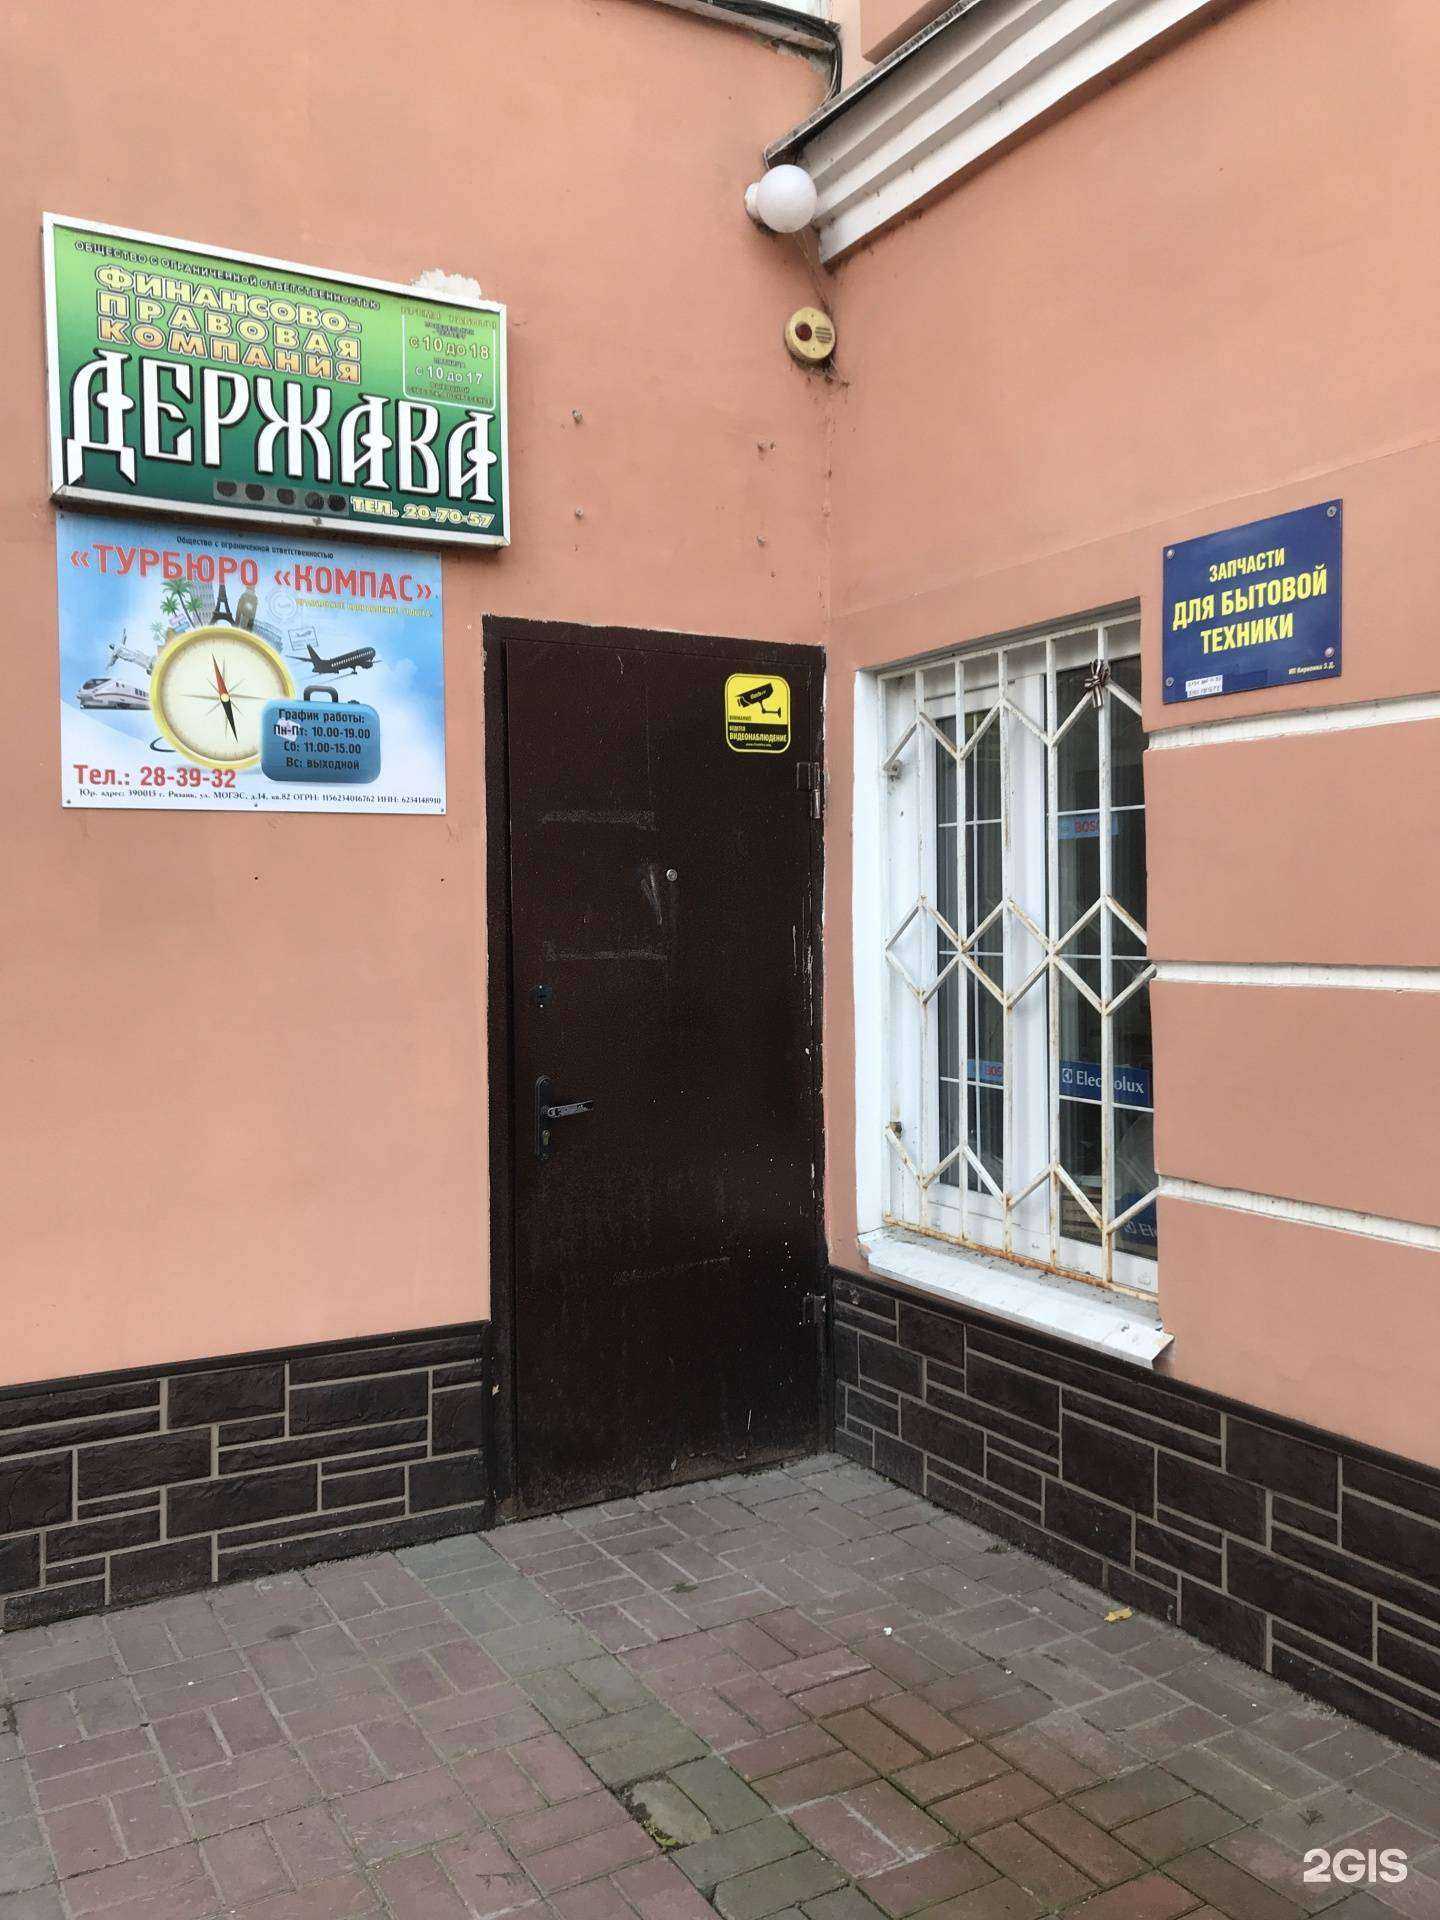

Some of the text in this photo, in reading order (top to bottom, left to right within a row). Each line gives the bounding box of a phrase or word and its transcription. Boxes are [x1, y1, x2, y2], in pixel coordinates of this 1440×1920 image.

[75, 240, 381, 311] ОБЩЕСТВО С ОГРАНИЧЕННОЙ ОТВЕТСТВЕННОСТЬЮ
[95, 264, 362, 335] ФИНАНСОВО-
[97, 290, 361, 361] ПРАВОВАЯ
[98, 316, 361, 384] КОМПАНИЯ
[423, 335, 443, 352] 10
[446, 343, 466, 356] до
[470, 343, 489, 360] 18
[427, 366, 444, 380] 10
[447, 373, 463, 382] до
[467, 372, 483, 384] 17
[66, 348, 498, 503] ДЕРЖАВА
[351, 496, 496, 529] ТЕЛ. 20-70-57
[176, 536, 212, 548] Общество
[221, 541, 270, 553] ограниченной
[272, 546, 334, 560] ответственностью
[70, 544, 432, 602] «ТУРБЮРО «КОМПАС»
[1209, 547, 1286, 583] ЗАПЧАСТИ
[1172, 563, 1327, 631] ДЛЯ БЫТОВОЙ
[1200, 613, 1294, 655] ТЕХНИКИ
[278, 709, 365, 723] График работы:
[274, 725, 371, 739] Пн-Пт: 10.00-19.00
[284, 741, 362, 754] Сб: 11.00-15.00
[73, 764, 236, 788] Тел.: 28-39-32
[286, 757, 360, 770] Вс: выходной
[80, 788, 98, 797] Юр.
[1076, 1070, 1145, 1095] Elecolux
